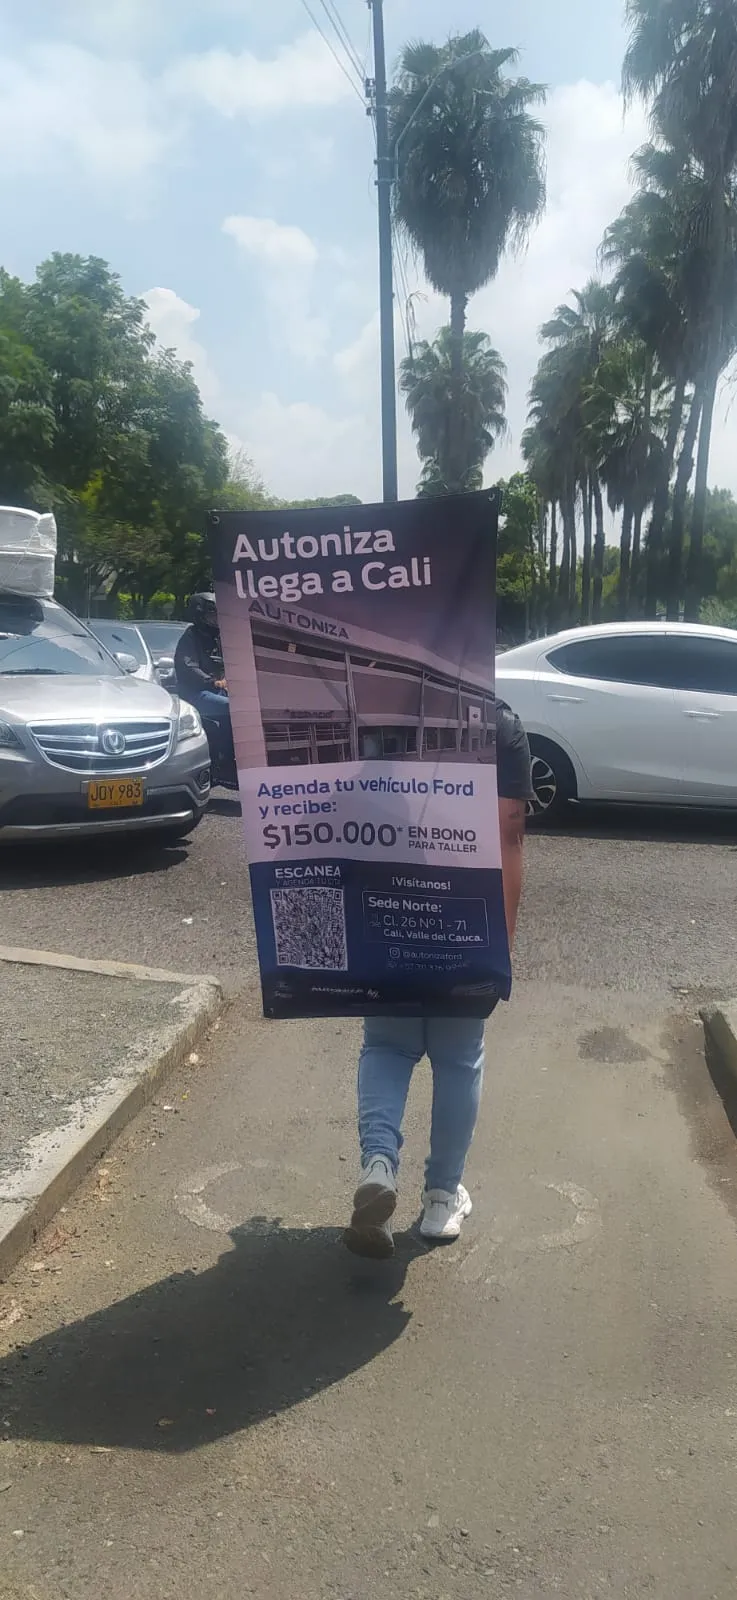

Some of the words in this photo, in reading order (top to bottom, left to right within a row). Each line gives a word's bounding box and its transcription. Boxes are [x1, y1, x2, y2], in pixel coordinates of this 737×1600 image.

[231, 525, 395, 563] Autoniza
[234, 569, 324, 601] llega
[331, 569, 354, 593] a
[361, 557, 432, 591] Cali
[248, 600, 350, 640] AUTONIZA
[91, 783, 115, 801] JOY
[118, 782, 141, 800] 983
[257, 780, 330, 799] Agenda
[335, 778, 354, 792] tu
[359, 777, 429, 794] vehículo
[433, 779, 474, 797] Ford
[259, 805, 269, 819] y
[274, 800, 337, 816] recibe:
[408, 826, 428, 839] EN
[431, 827, 476, 842] BONO
[408, 840, 436, 850] PARA
[438, 841, 477, 854] TALLER
[274, 865, 342, 879] ESCANEA
[368, 896, 400, 909] Sede
[402, 899, 443, 913] Norte:
[383, 914, 399, 927] Cl.
[400, 916, 417, 928] 26
[453, 920, 467, 931] 71
[406, 931, 430, 940] Valle
[431, 933, 447, 942] del
[448, 933, 484, 942] Cauca.
